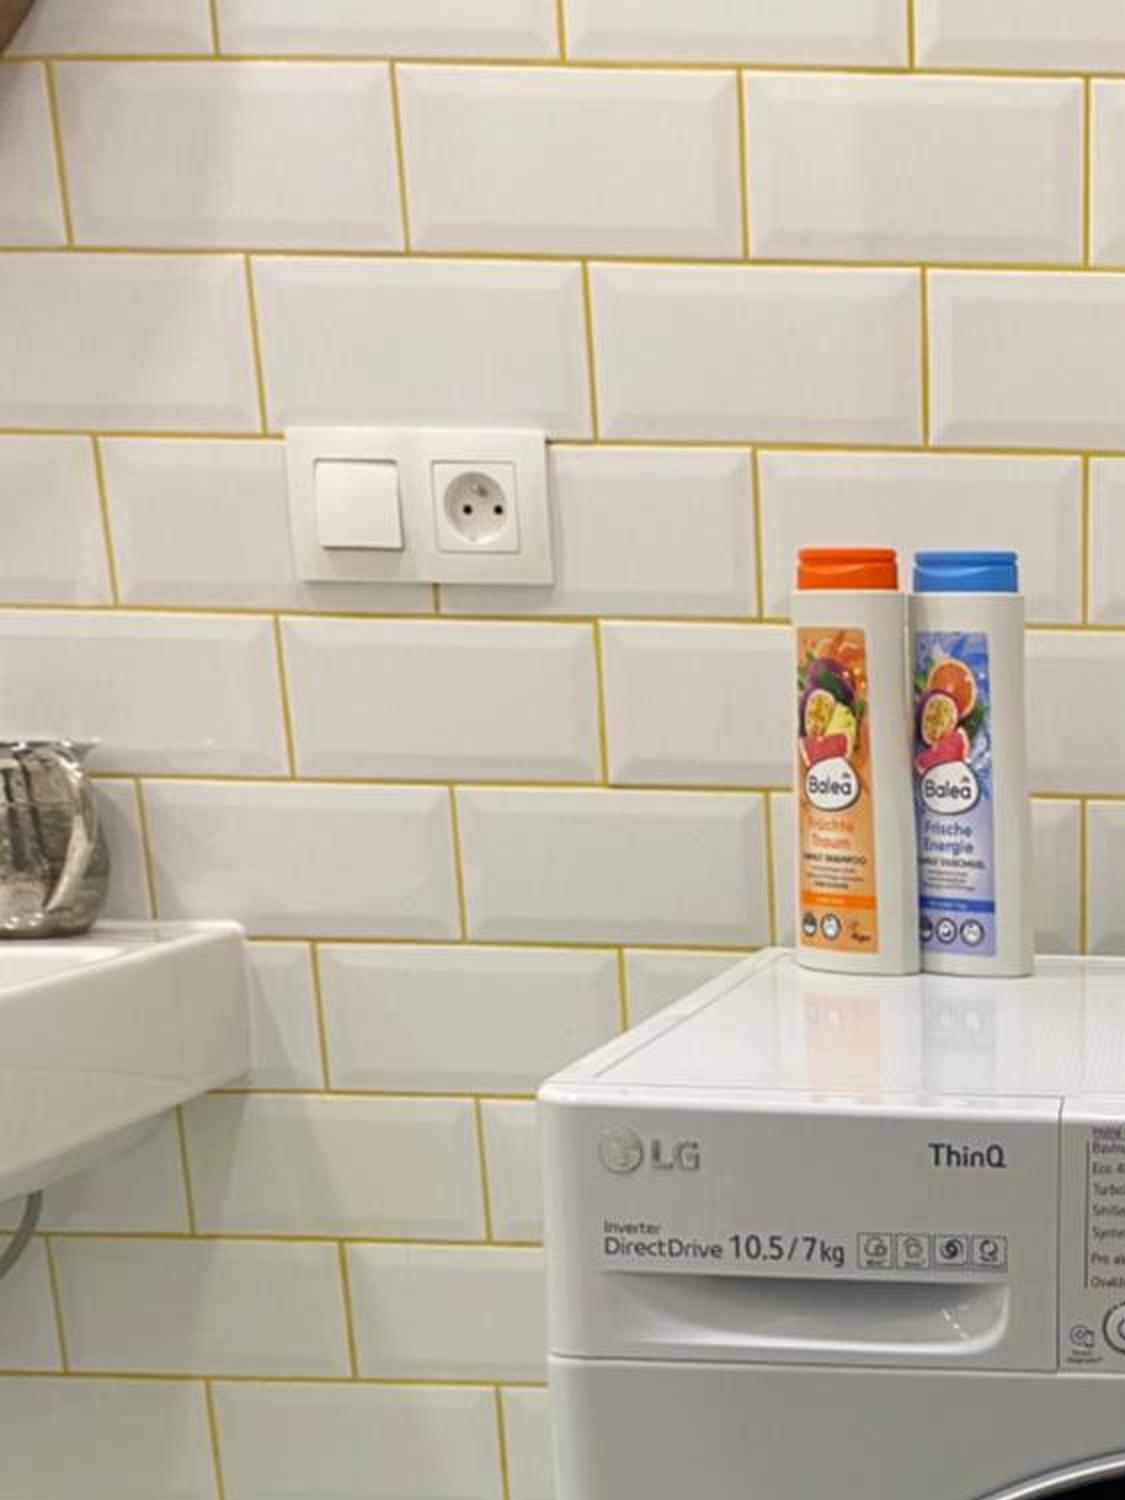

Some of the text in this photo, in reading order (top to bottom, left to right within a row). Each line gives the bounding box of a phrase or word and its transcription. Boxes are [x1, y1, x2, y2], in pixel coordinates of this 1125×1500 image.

[808, 775, 853, 796] Balea
[924, 779, 972, 800] Balea
[649, 1139, 700, 1172] LG
[927, 1143, 1008, 1169] ThinQ
[603, 1221, 661, 1235] Inverter
